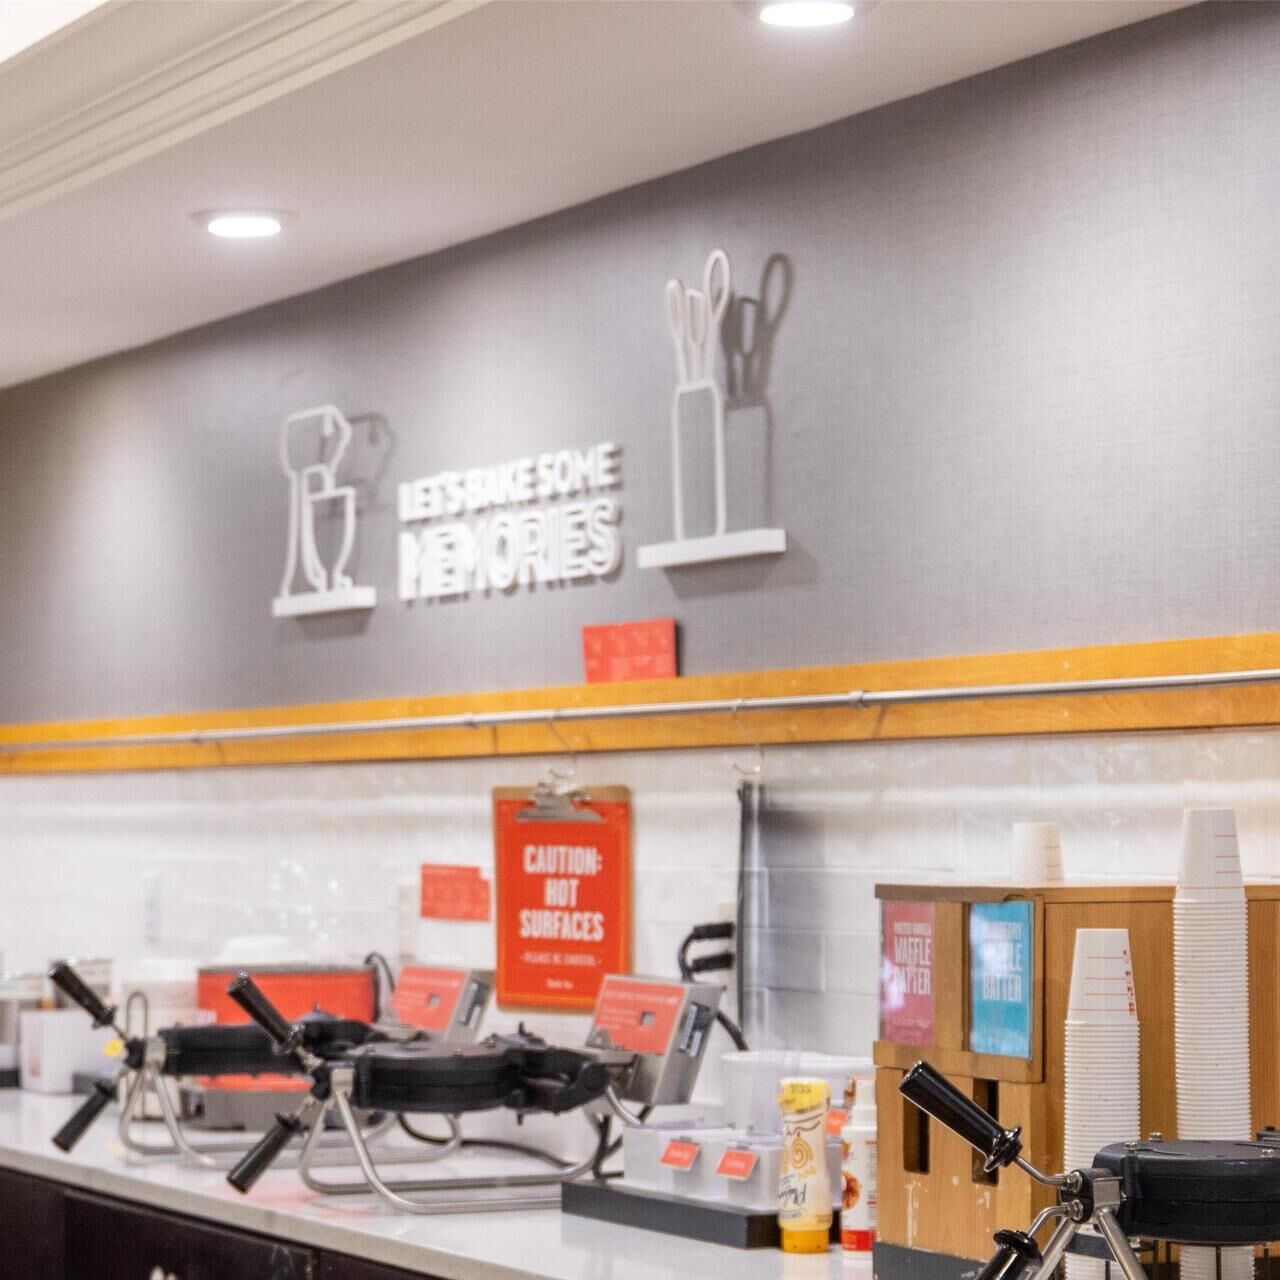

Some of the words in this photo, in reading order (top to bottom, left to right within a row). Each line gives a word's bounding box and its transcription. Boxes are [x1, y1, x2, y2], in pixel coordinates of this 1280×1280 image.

[538, 442, 614, 494] SOME
[398, 496, 618, 600] MEMORIES
[523, 844, 603, 875] CAUTION:
[544, 877, 580, 908] HOT
[518, 909, 605, 942] SURFACES
[894, 936, 932, 967] WAFFLE
[982, 942, 1023, 972] WFLE
[894, 966, 931, 996] BATTER
[982, 974, 1023, 1003] BATTER
